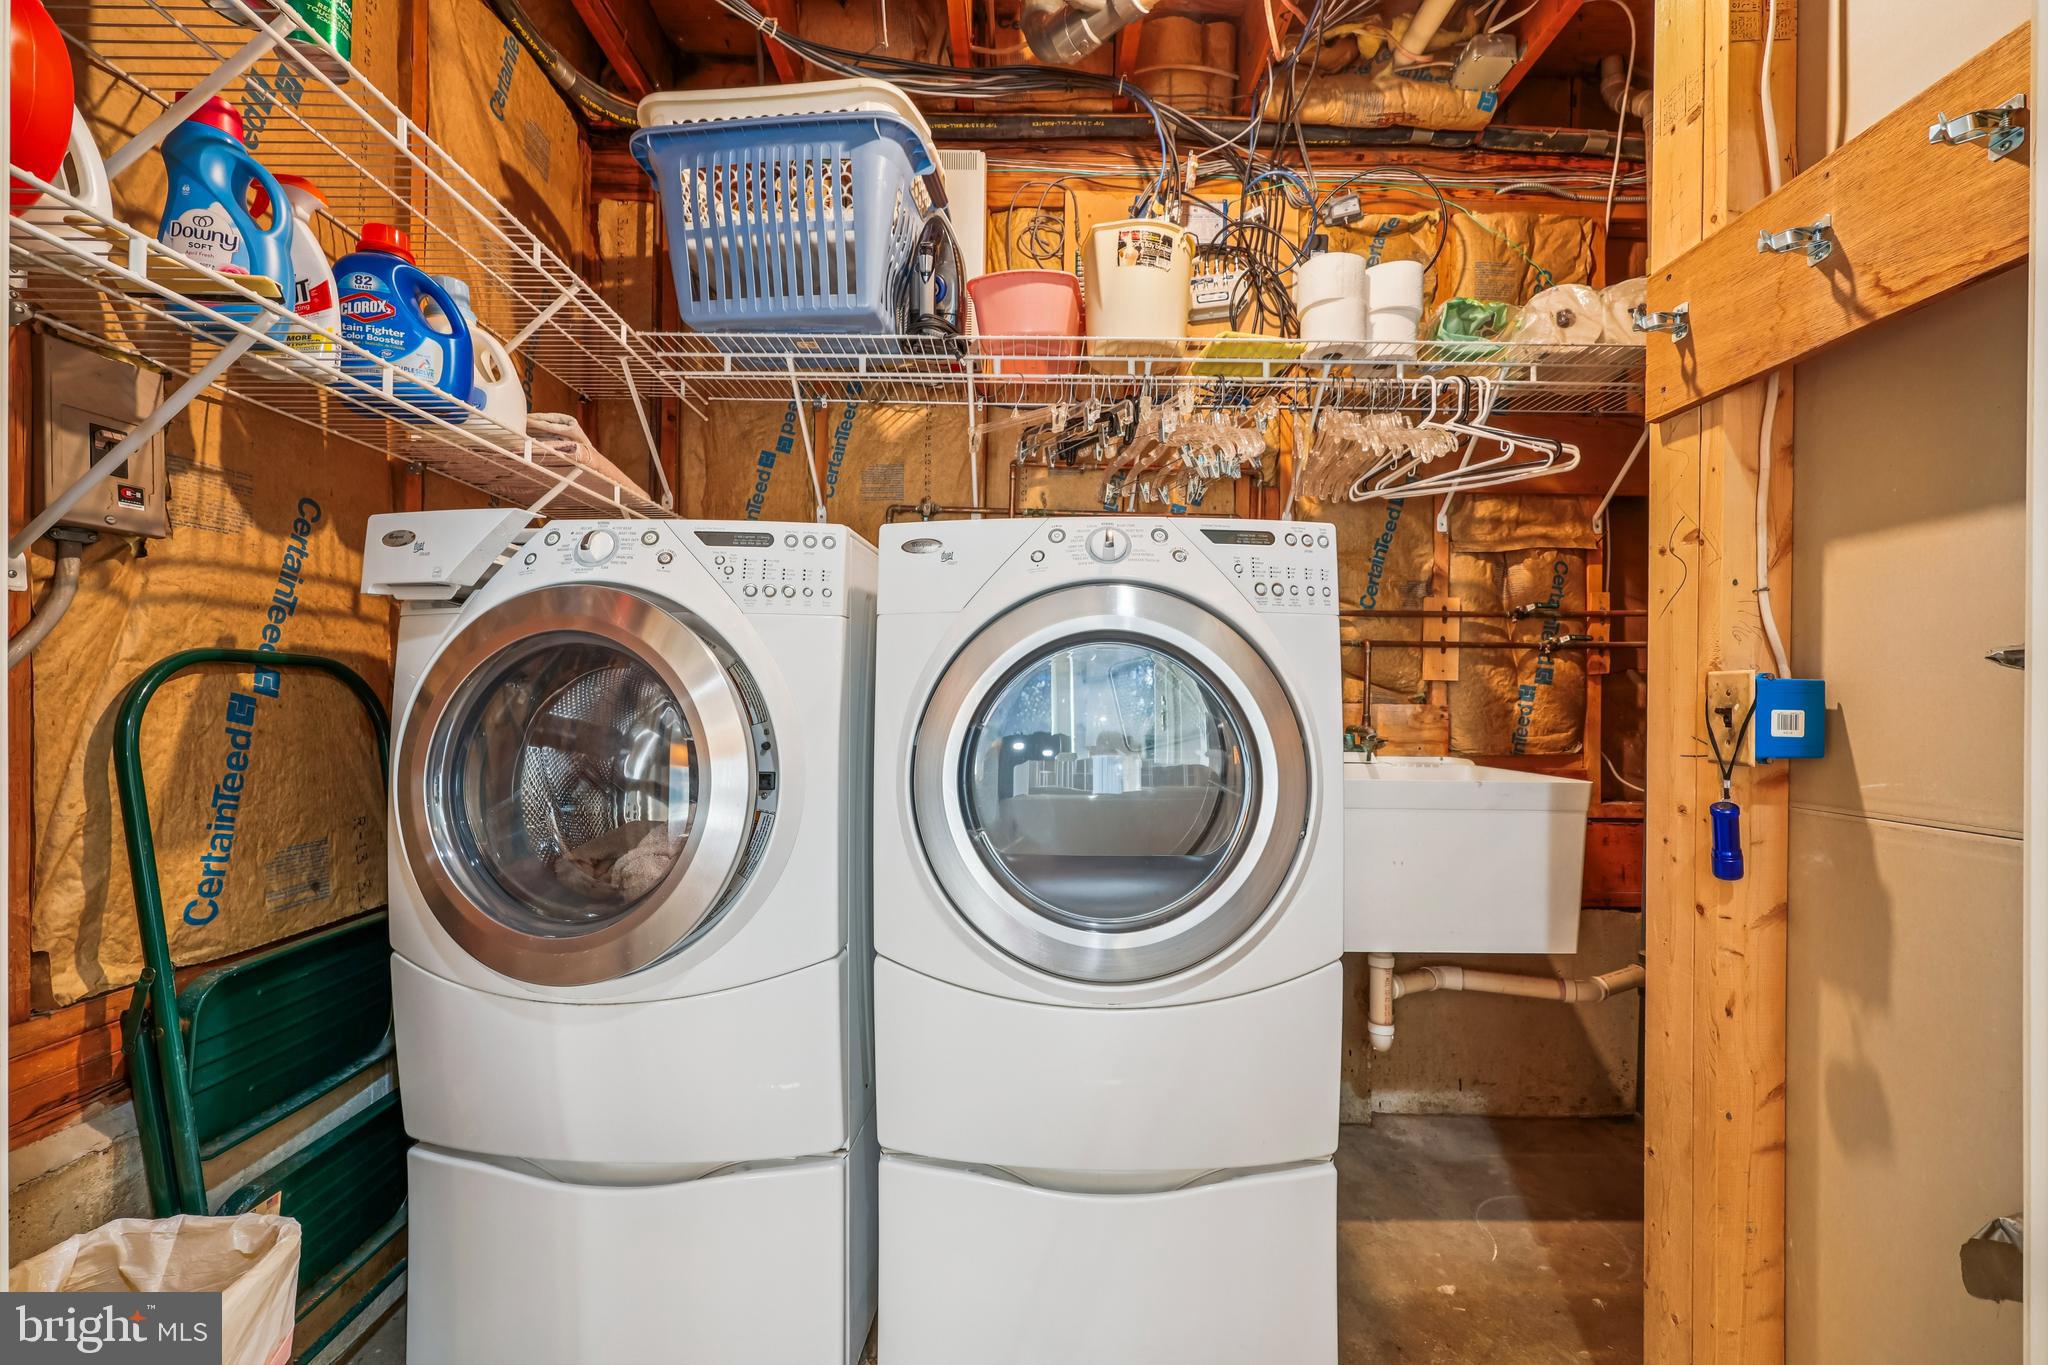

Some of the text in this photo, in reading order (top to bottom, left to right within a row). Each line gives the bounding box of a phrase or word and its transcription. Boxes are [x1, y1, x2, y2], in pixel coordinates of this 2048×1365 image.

[489, 34, 520, 122] CertainTe
[170, 221, 239, 252] Downy
[188, 241, 213, 251] SOFT
[354, 274, 373, 285] 82
[341, 300, 386, 315] CLOROX
[342, 322, 405, 338] tain Fighter
[286, 334, 313, 342] MORE
[342, 331, 365, 340] Color
[366, 333, 405, 346] Booster
[1359, 505, 1401, 610] CertainTeed
[182, 726, 253, 926] CertainTeed
